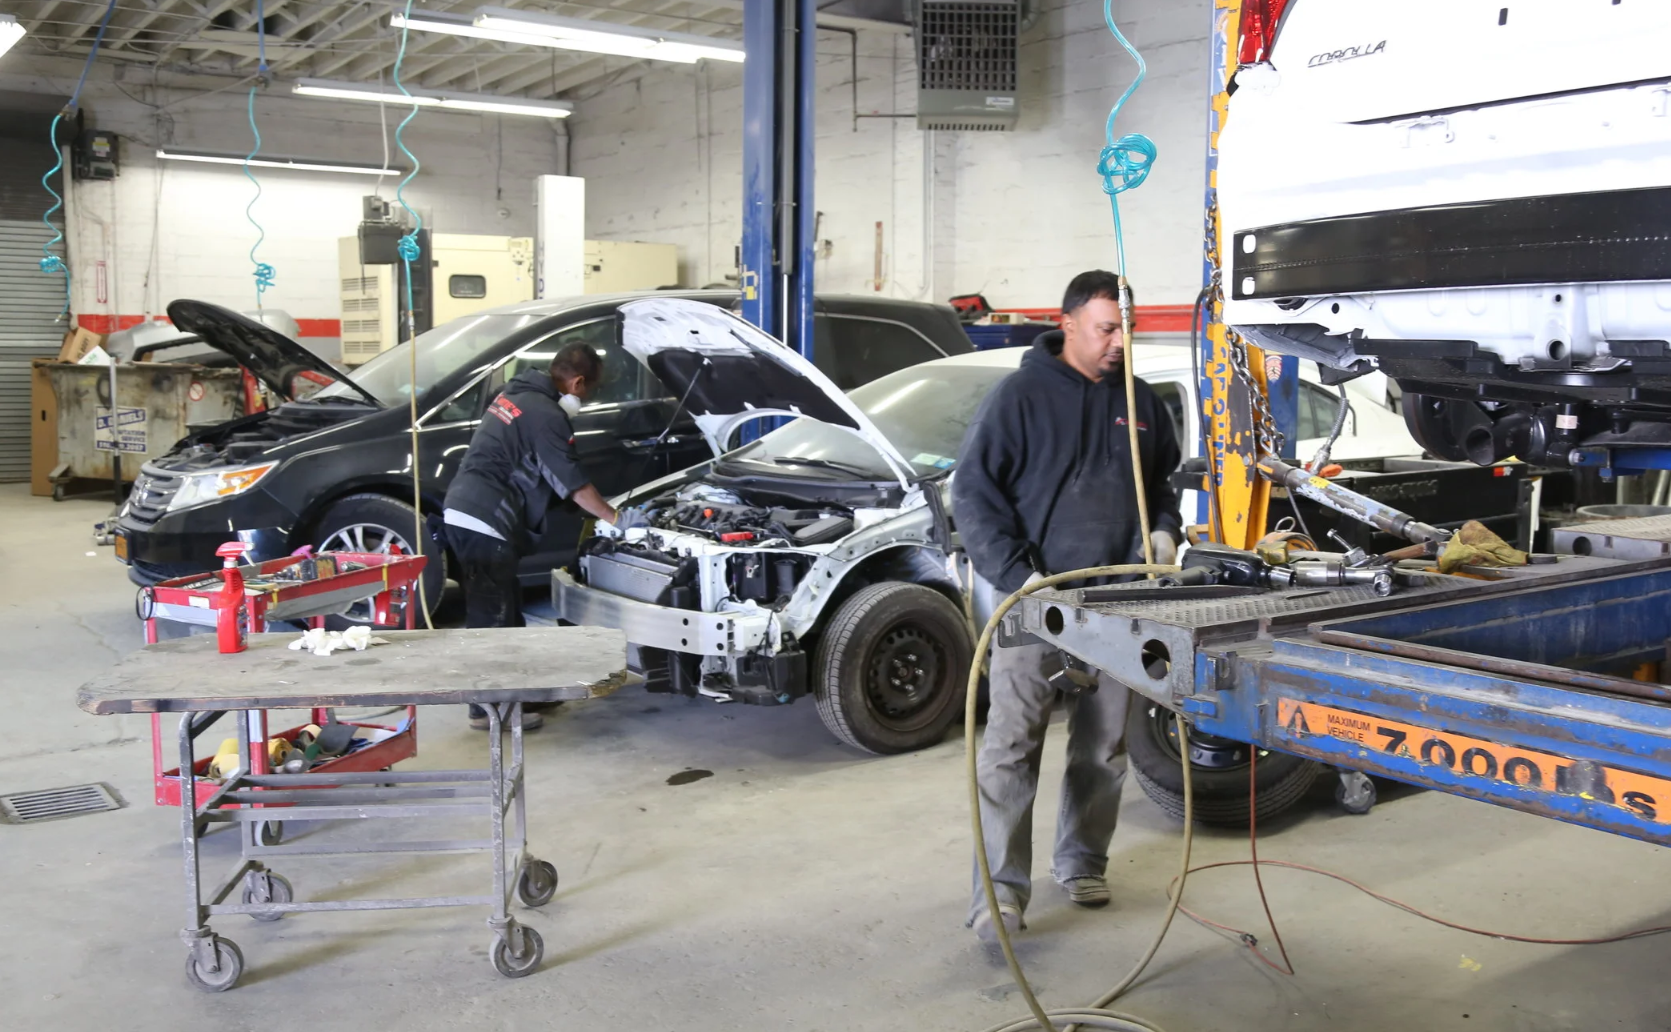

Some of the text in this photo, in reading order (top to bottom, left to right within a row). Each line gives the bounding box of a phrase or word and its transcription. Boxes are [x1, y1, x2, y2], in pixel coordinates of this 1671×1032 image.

[1327, 714, 1371, 731] MAXIMUM
[1327, 726, 1365, 743] VEHICLE
[1376, 726, 1543, 787] 7000
